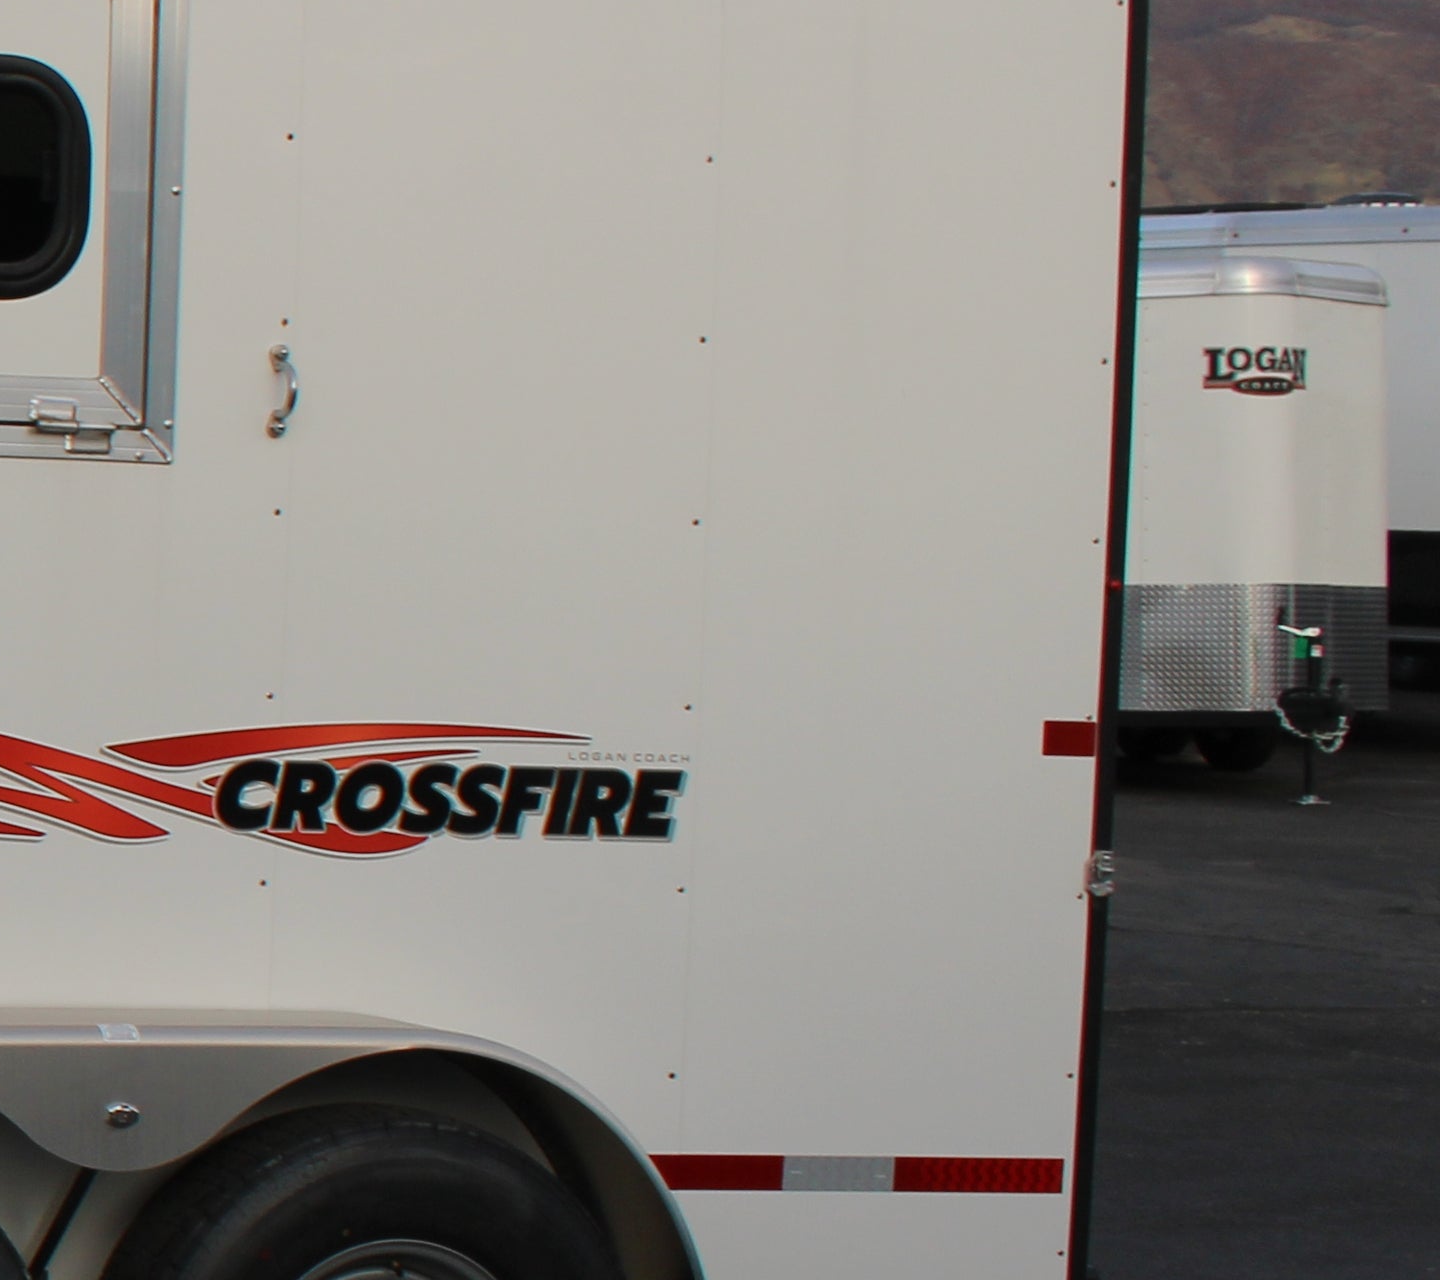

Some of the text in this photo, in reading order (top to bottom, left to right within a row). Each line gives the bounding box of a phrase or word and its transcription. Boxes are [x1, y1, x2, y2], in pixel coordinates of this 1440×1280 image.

[1203, 347, 1307, 384] LOGAN
[567, 751, 691, 763] LOGAN COACH
[214, 759, 688, 841] CROSSFIRE
